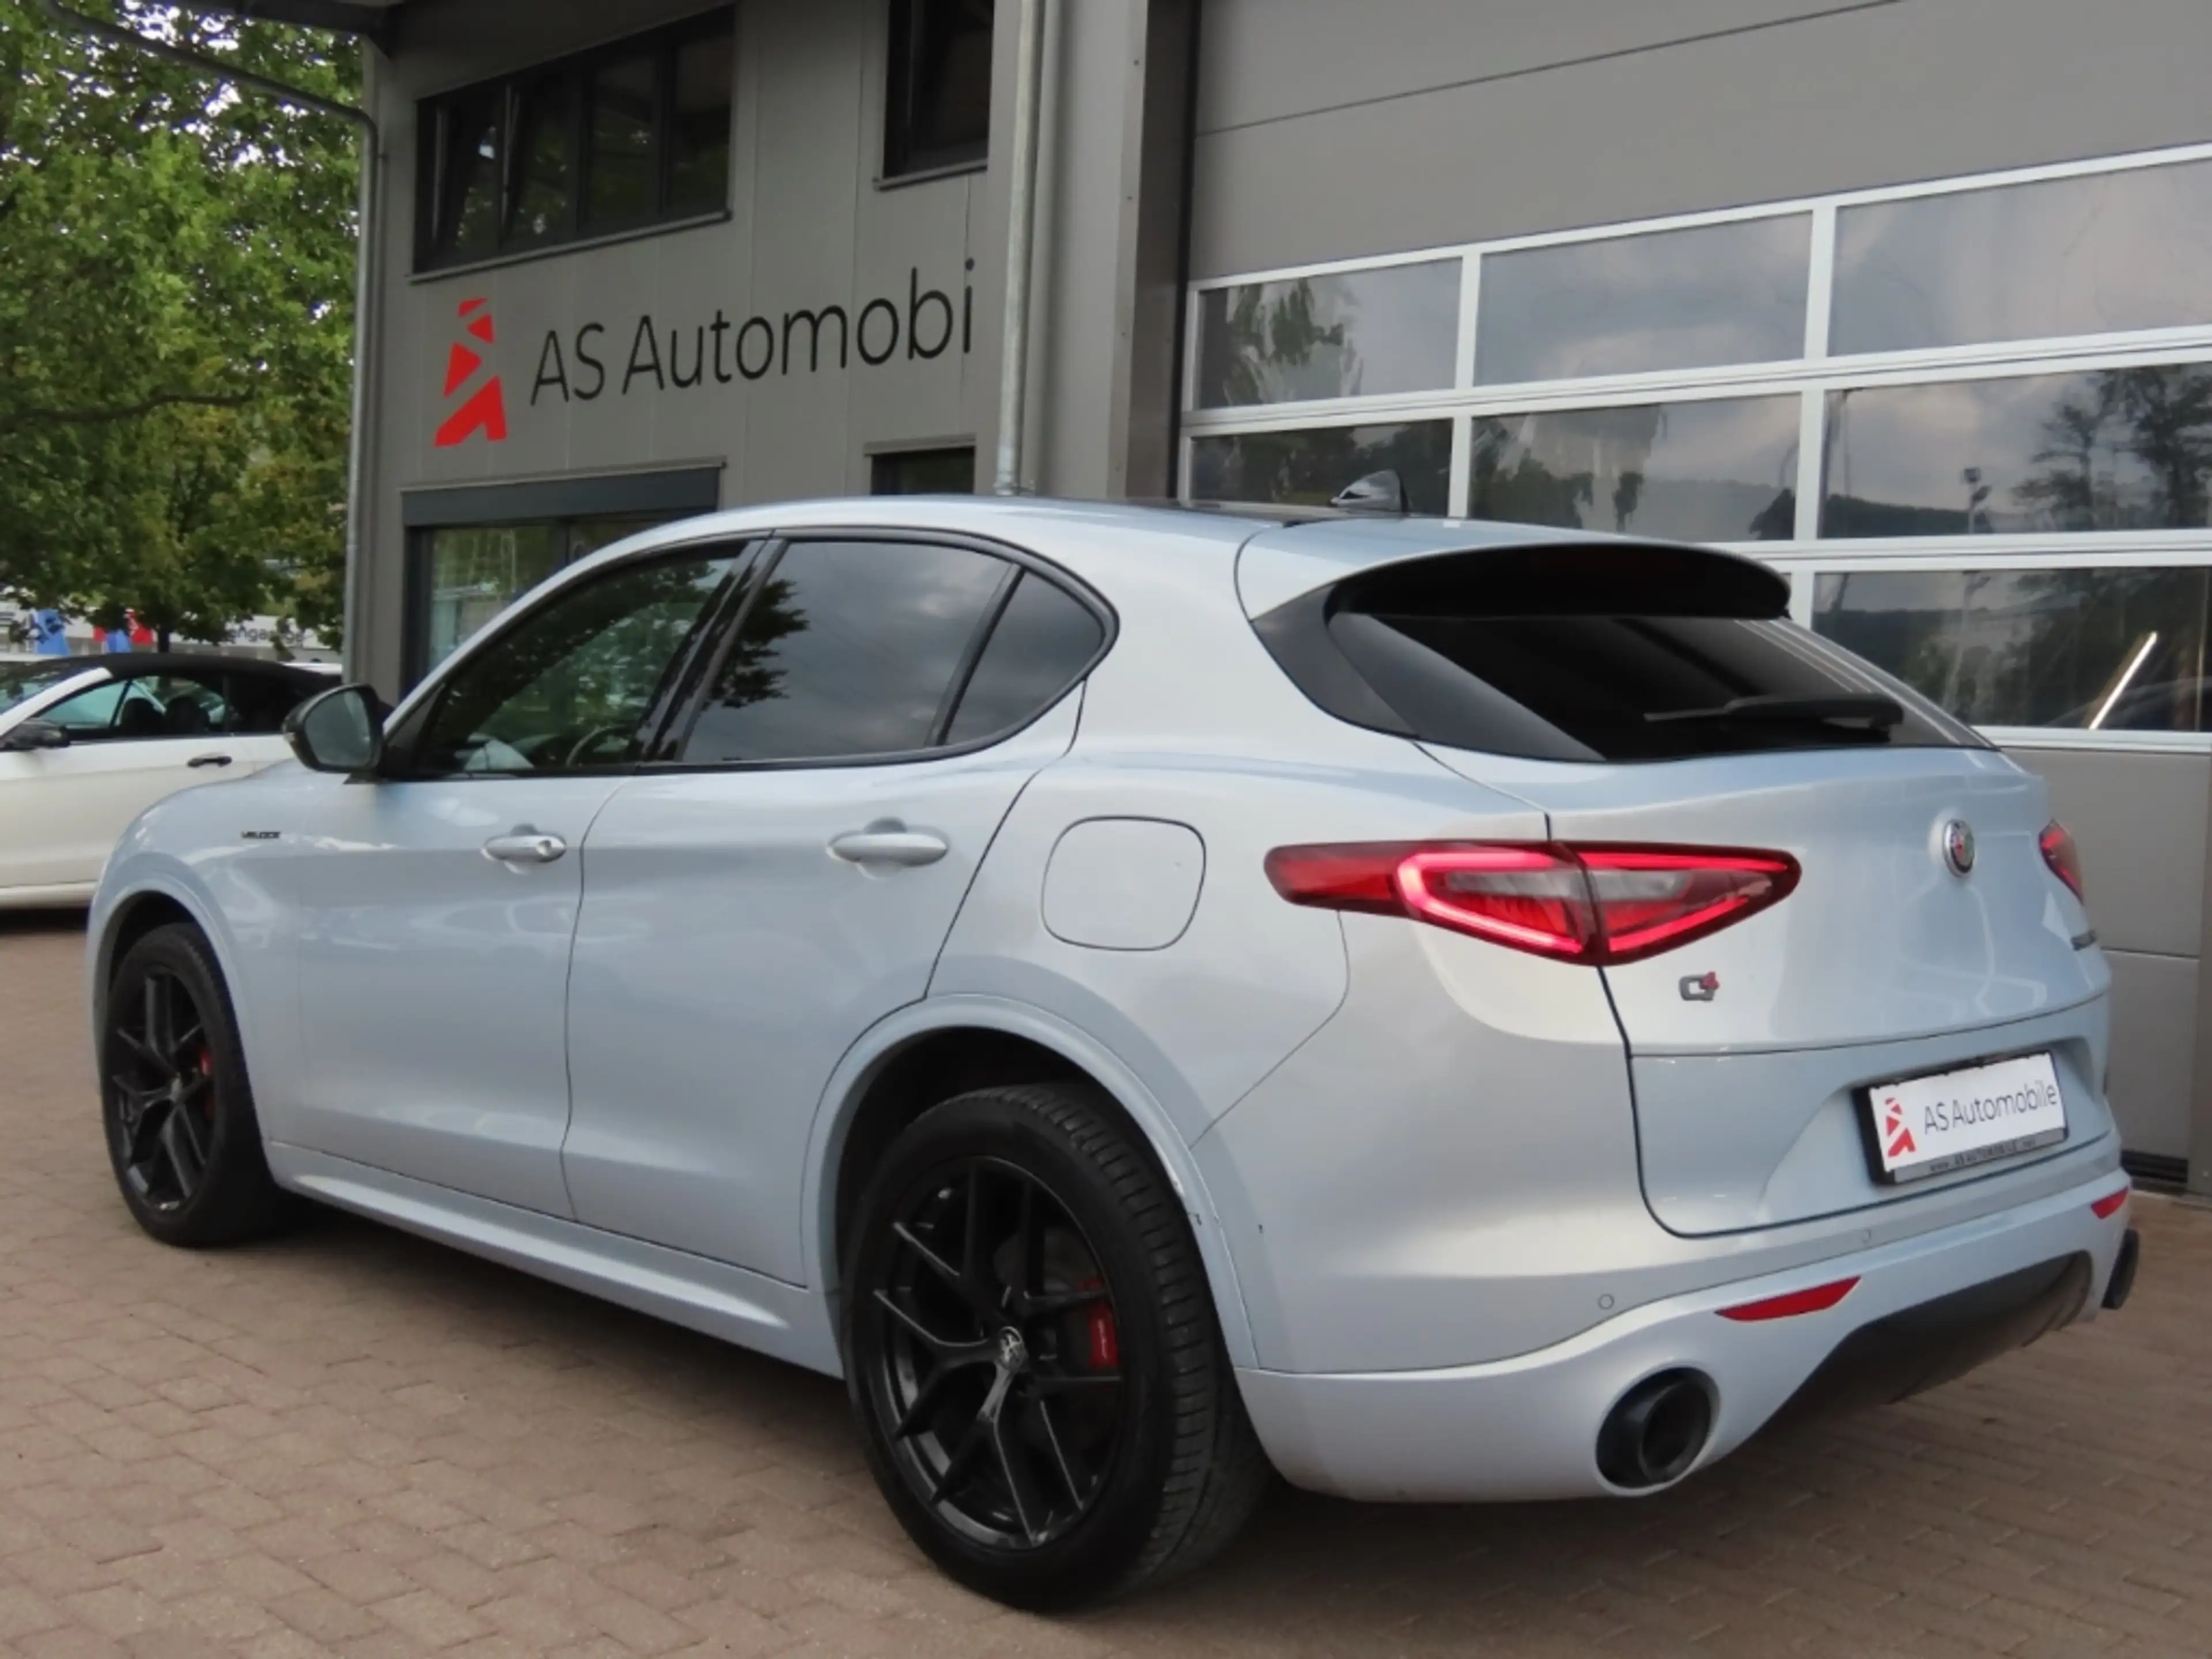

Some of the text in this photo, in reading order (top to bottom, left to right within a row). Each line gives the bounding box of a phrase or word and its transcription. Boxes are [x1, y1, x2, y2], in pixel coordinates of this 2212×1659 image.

[530, 322, 605, 407] AS
[1924, 1080, 2058, 1135] AS Automobile
